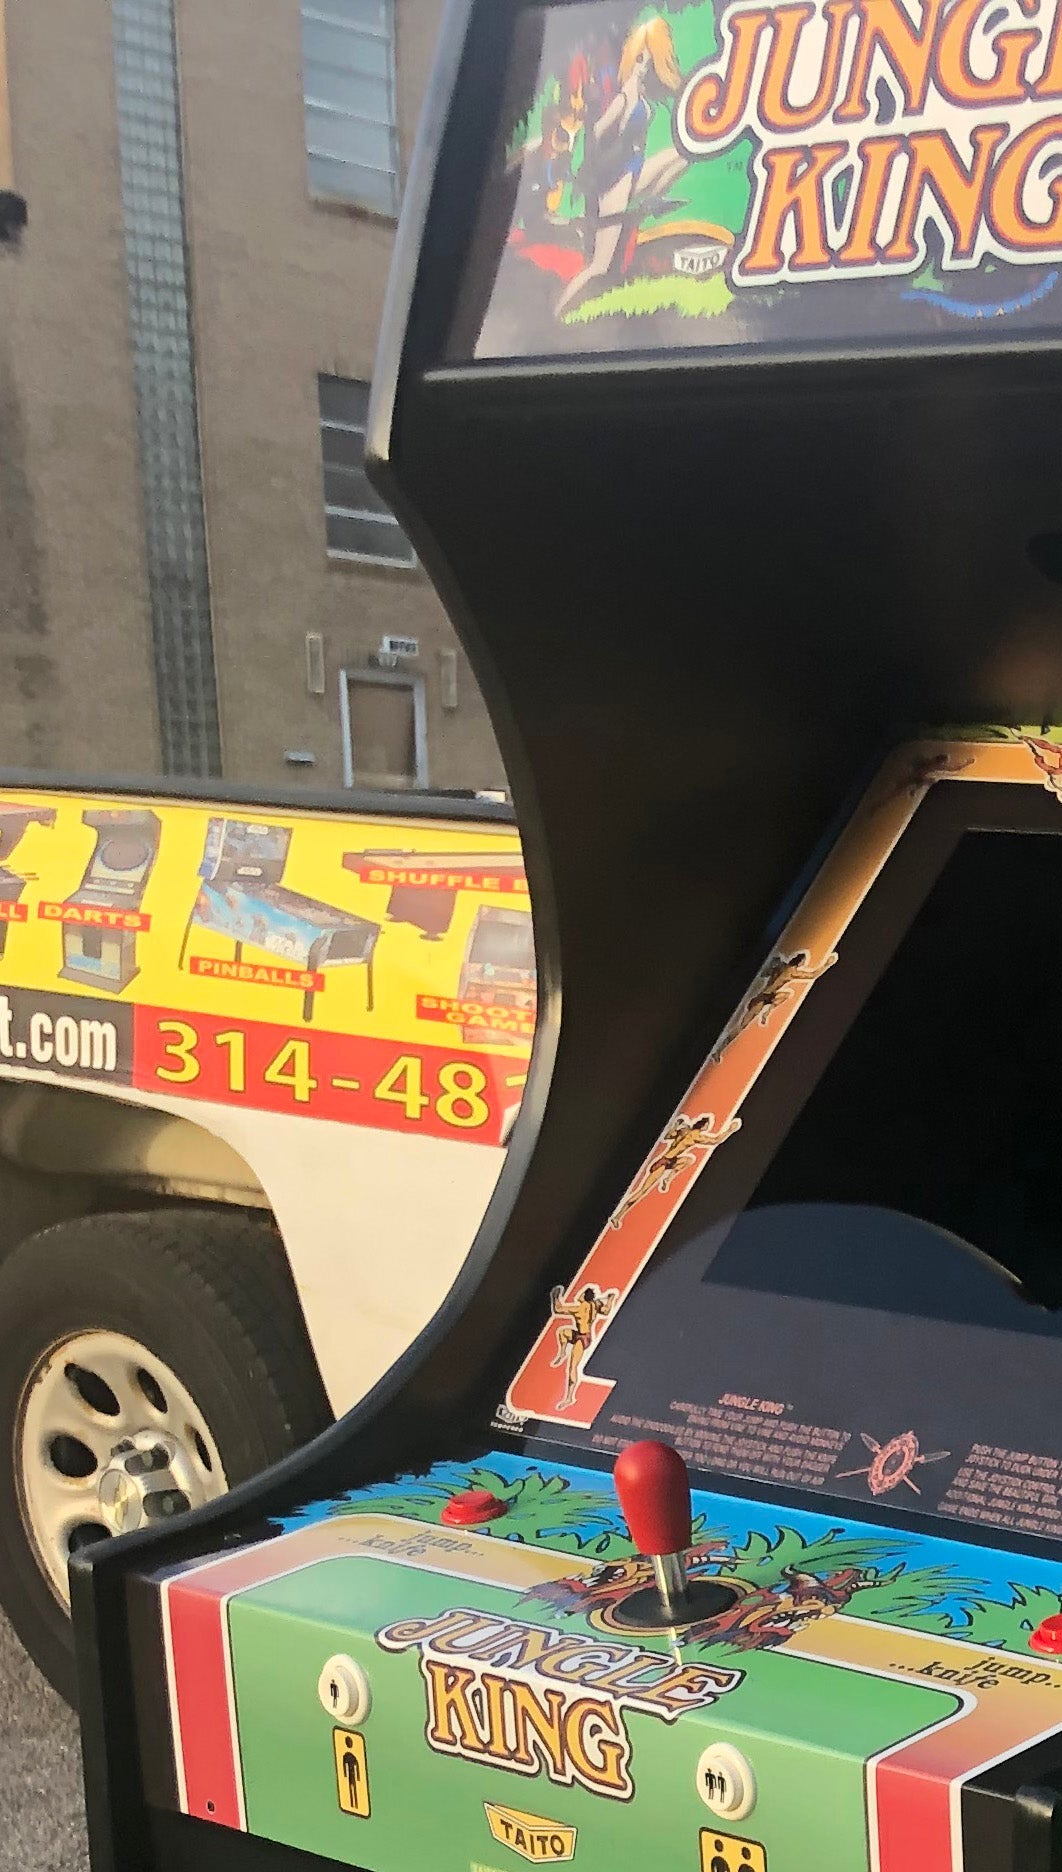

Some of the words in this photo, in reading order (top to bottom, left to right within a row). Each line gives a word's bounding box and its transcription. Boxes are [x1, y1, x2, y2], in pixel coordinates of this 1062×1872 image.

[369, 869, 501, 890] SHUFFLE
[44, 904, 143, 928] DARTS
[198, 958, 315, 991] PINBALLS
[718, 1393, 758, 1411] JUNGLE
[757, 1399, 785, 1415] KING
[385, 1611, 738, 1712] JUNGLE
[426, 1660, 629, 1791] KING
[499, 1818, 566, 1857] TAITO
